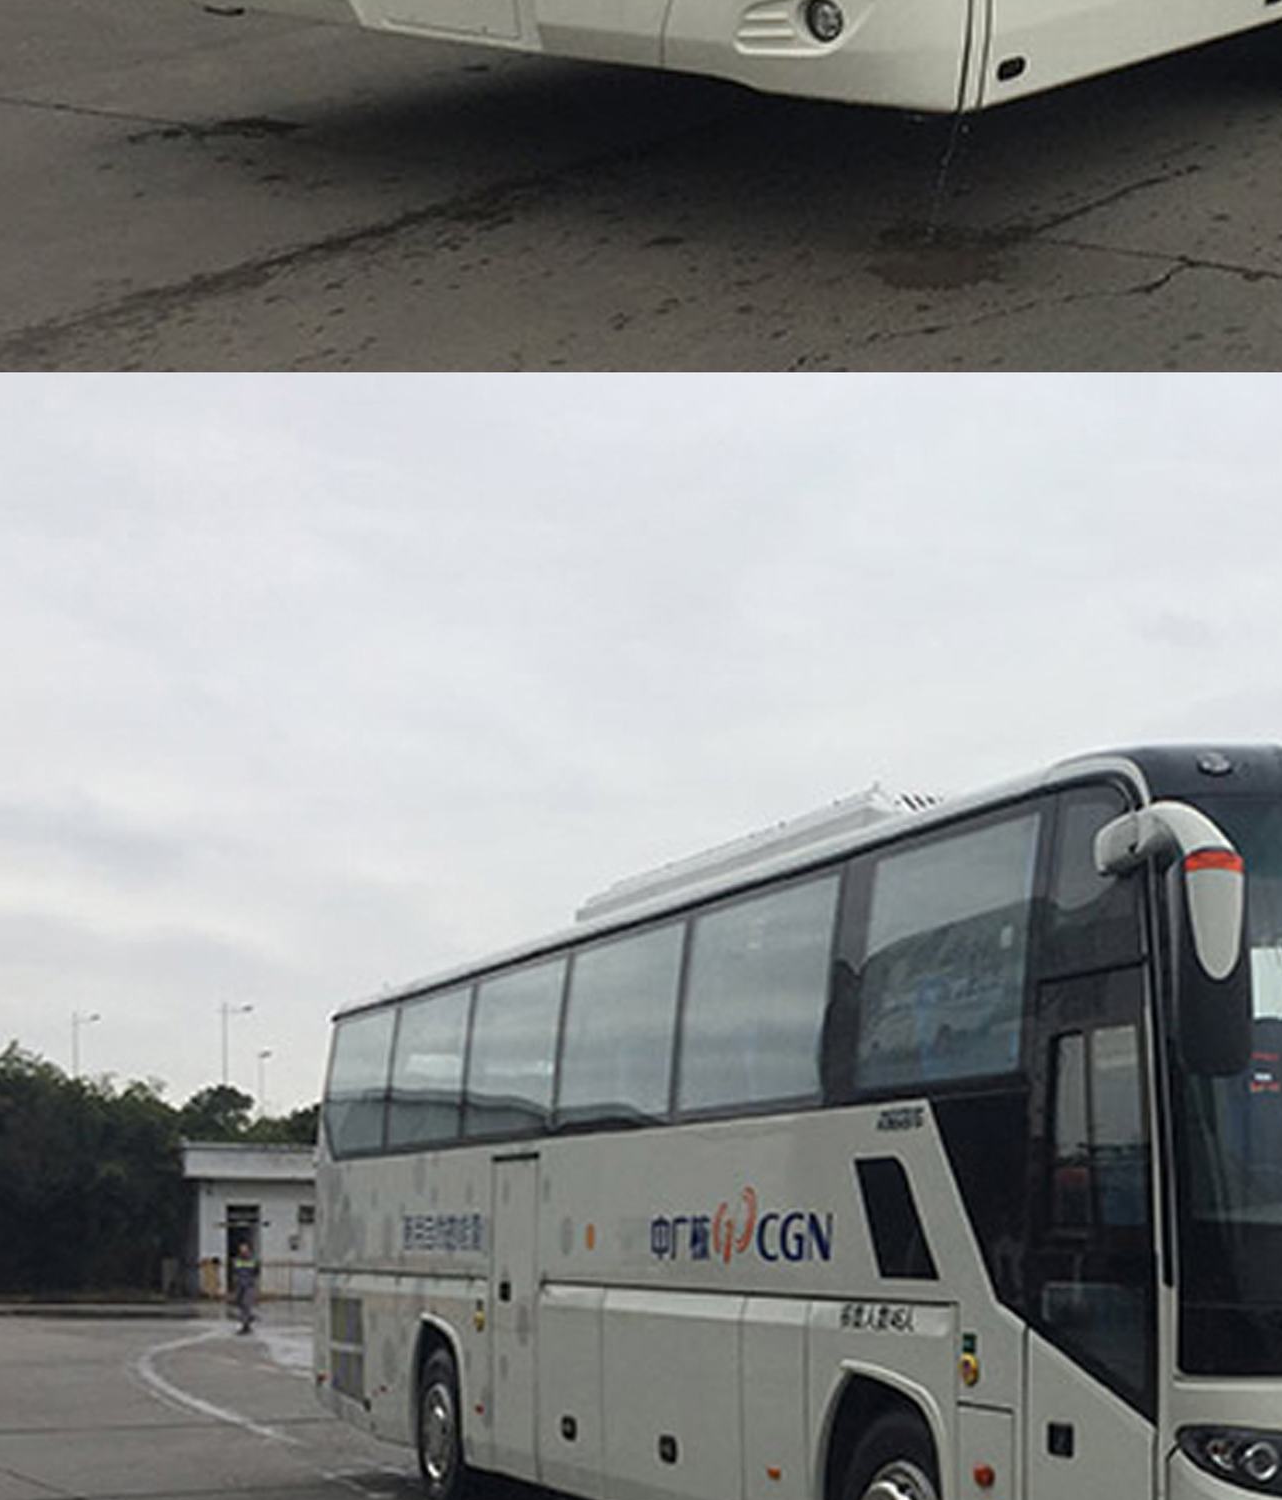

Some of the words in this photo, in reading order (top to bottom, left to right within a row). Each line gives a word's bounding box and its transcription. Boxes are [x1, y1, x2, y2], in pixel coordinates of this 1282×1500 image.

[651, 1216, 711, 1260] 中广核
[757, 1212, 834, 1262] CGN
